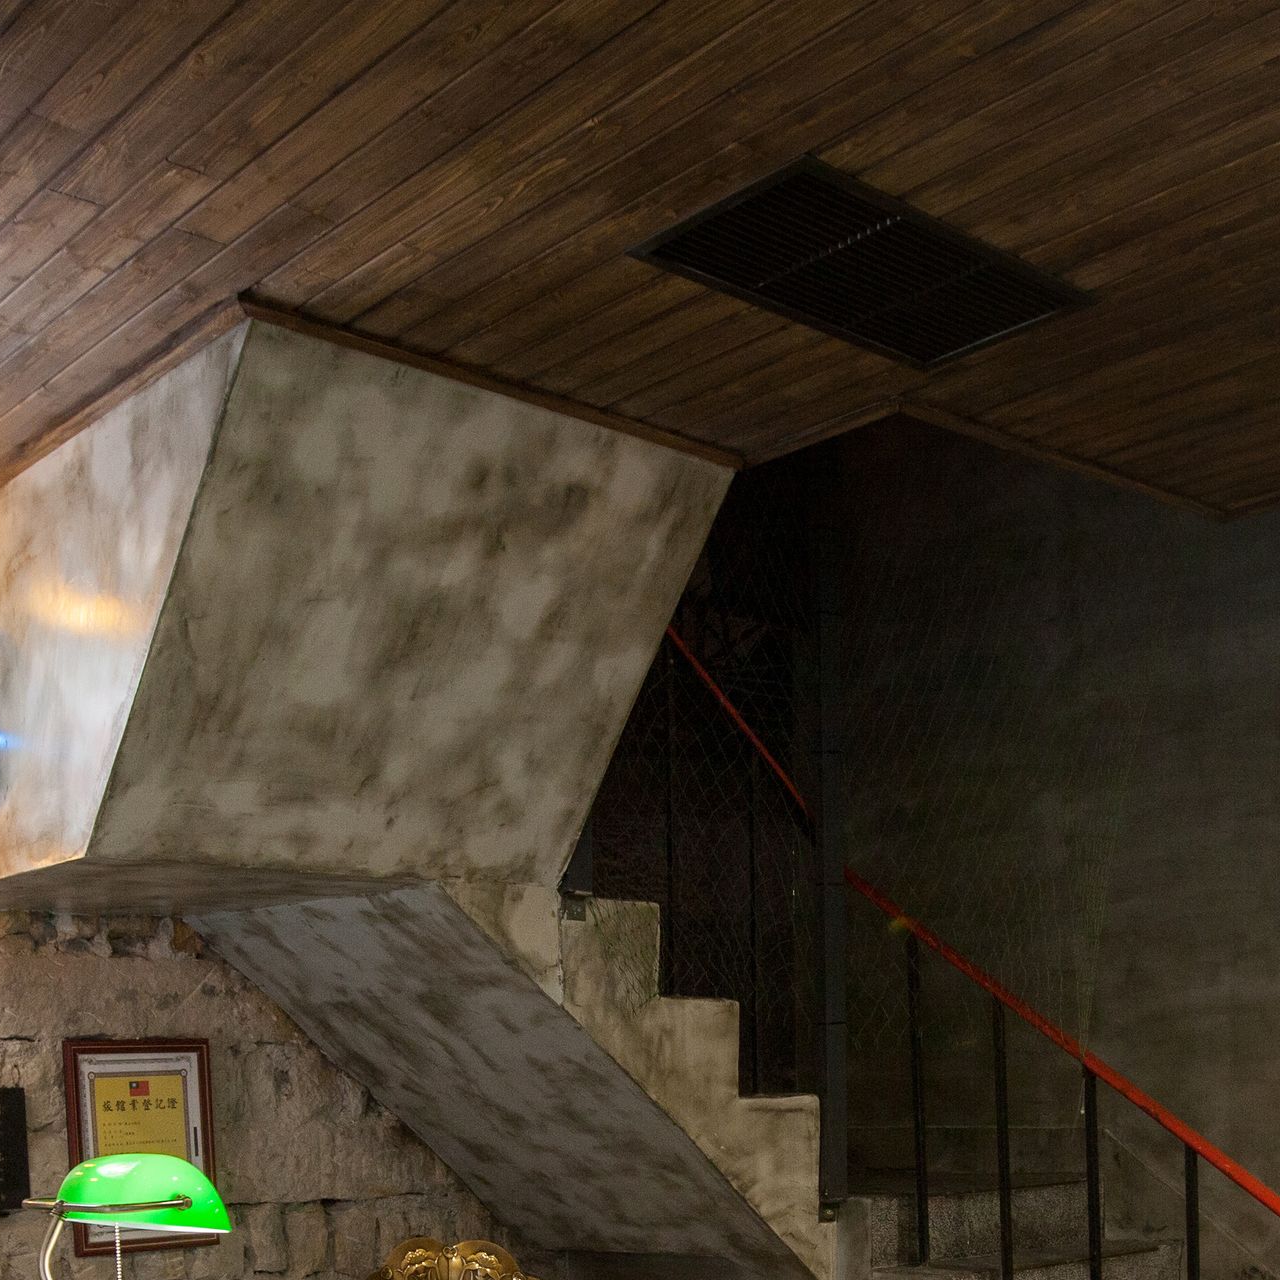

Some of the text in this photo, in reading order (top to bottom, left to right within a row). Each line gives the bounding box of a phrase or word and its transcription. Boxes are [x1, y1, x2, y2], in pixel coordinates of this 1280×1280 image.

[103, 1098, 178, 1112] 旅館業登記證
